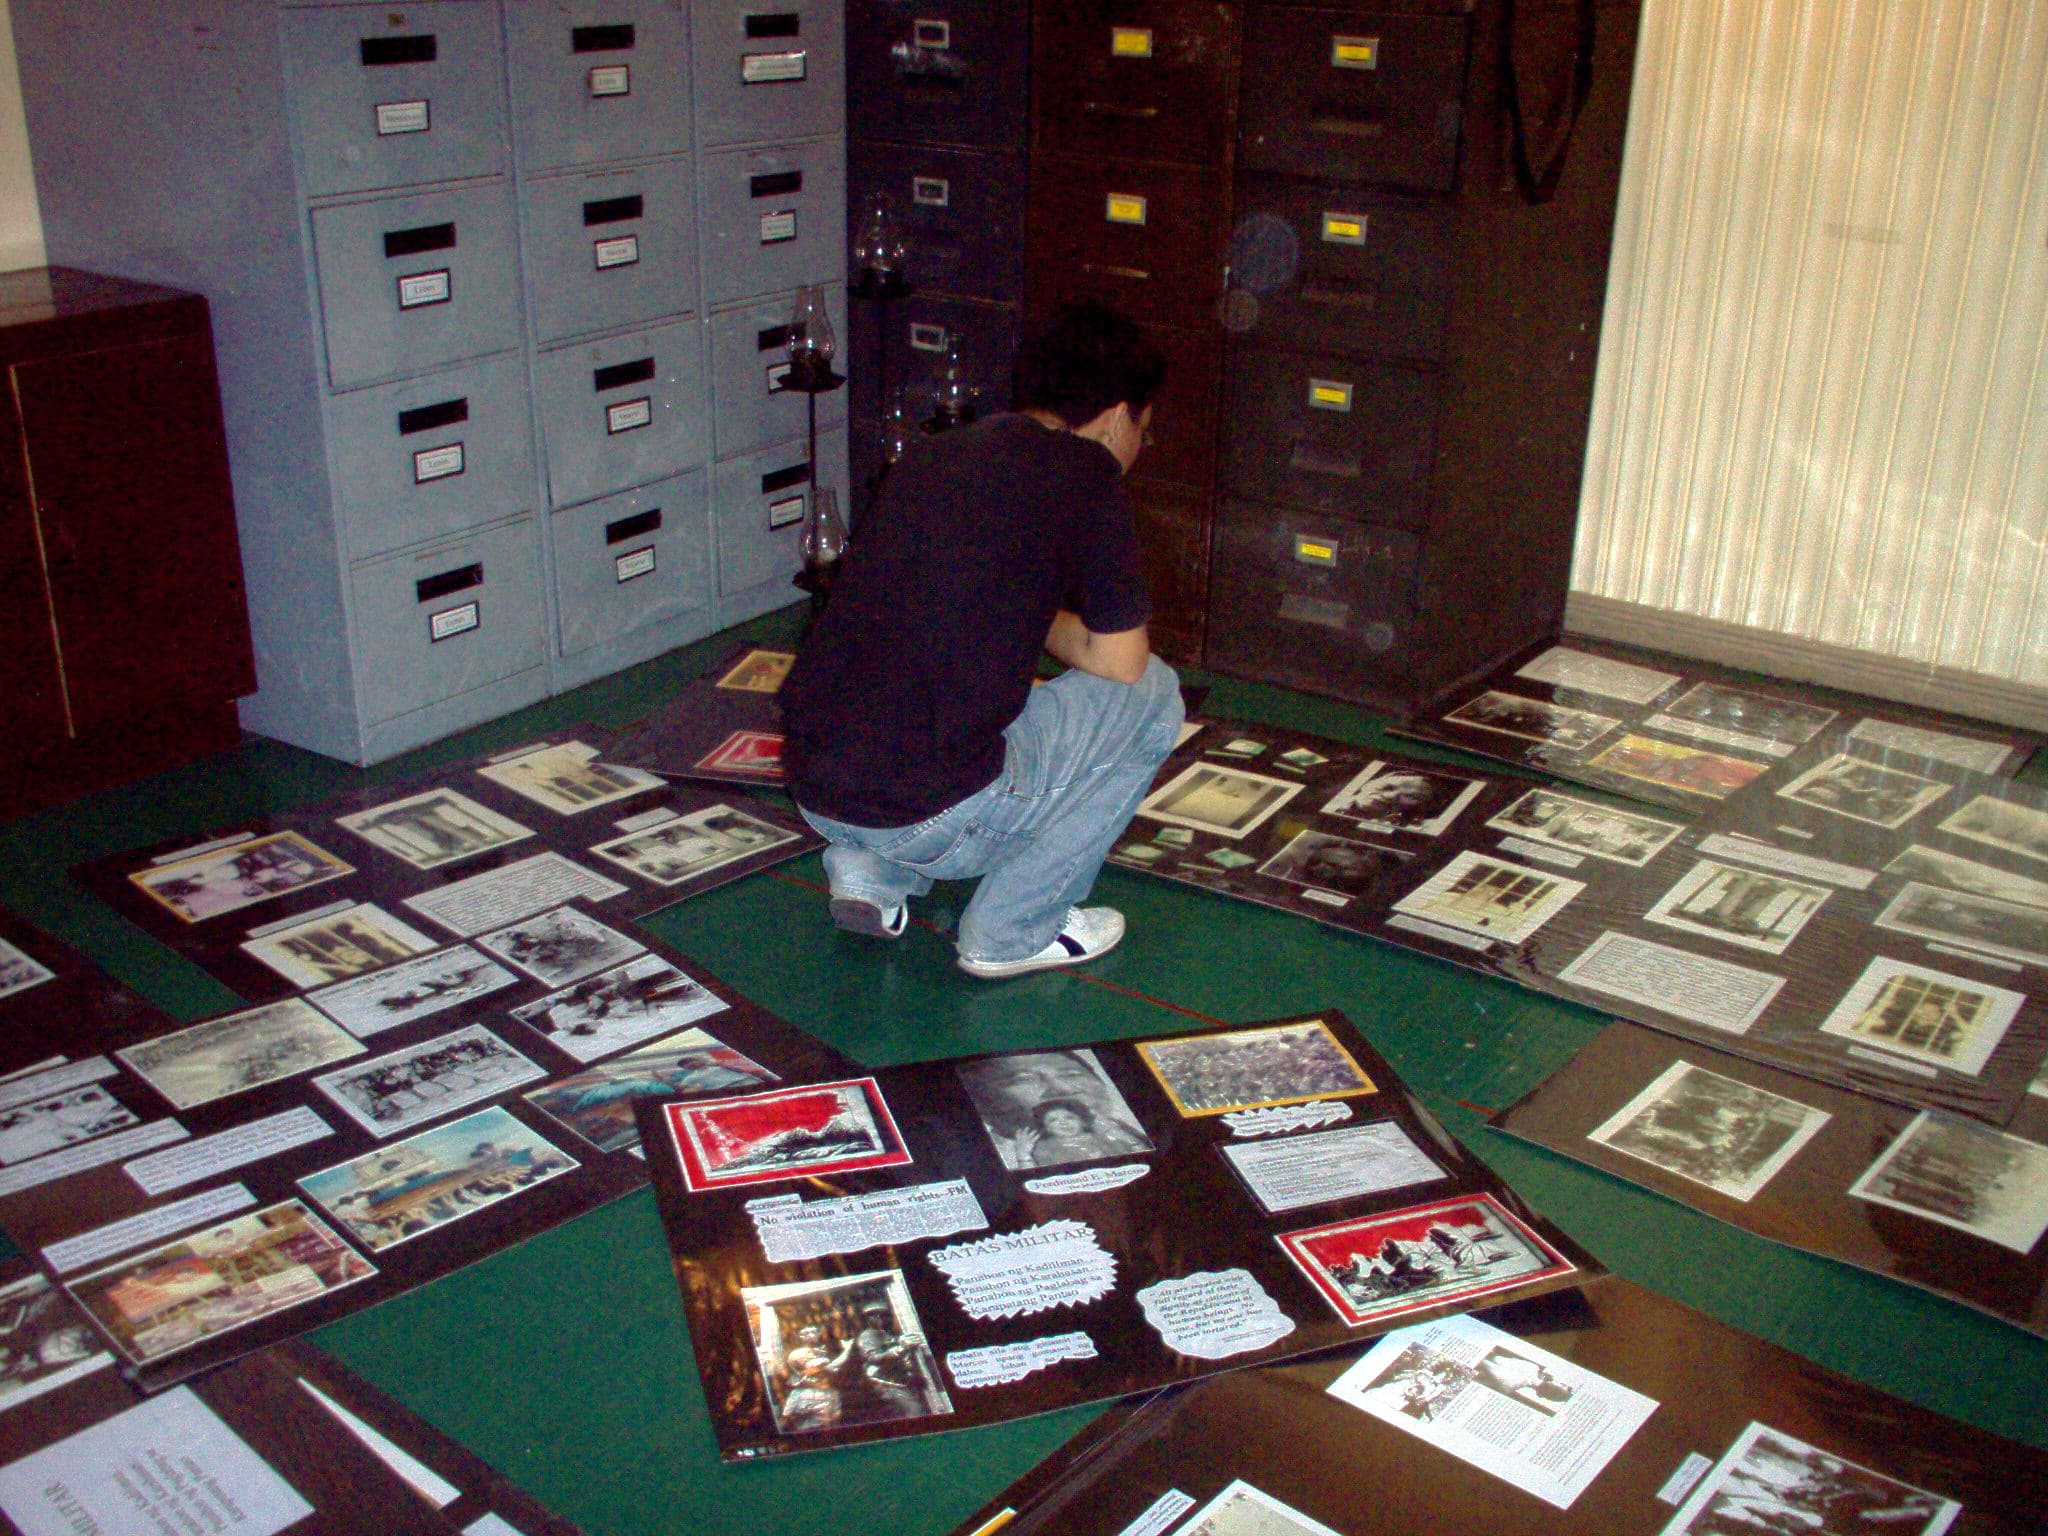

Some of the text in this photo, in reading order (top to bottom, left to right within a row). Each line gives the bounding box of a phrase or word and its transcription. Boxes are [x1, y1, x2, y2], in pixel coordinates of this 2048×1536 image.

[760, 1215, 779, 1227] No
[785, 1207, 836, 1222] violation
[843, 1203, 855, 1213] of
[861, 1199, 901, 1211] human
[933, 1241, 1002, 1263] BATAS
[1005, 1226, 1094, 1250] MILITAR
[955, 1270, 1005, 1286] Panahon
[1008, 1268, 1023, 1277] ng
[960, 1279, 1011, 1295] Panahon
[1013, 1277, 1028, 1286] ng
[965, 1289, 1016, 1305] Panahon
[1018, 1287, 1034, 1296] ng
[1035, 1276, 1089, 1292] Paglabag
[970, 1288, 1080, 1315] Karapatang Pantao
